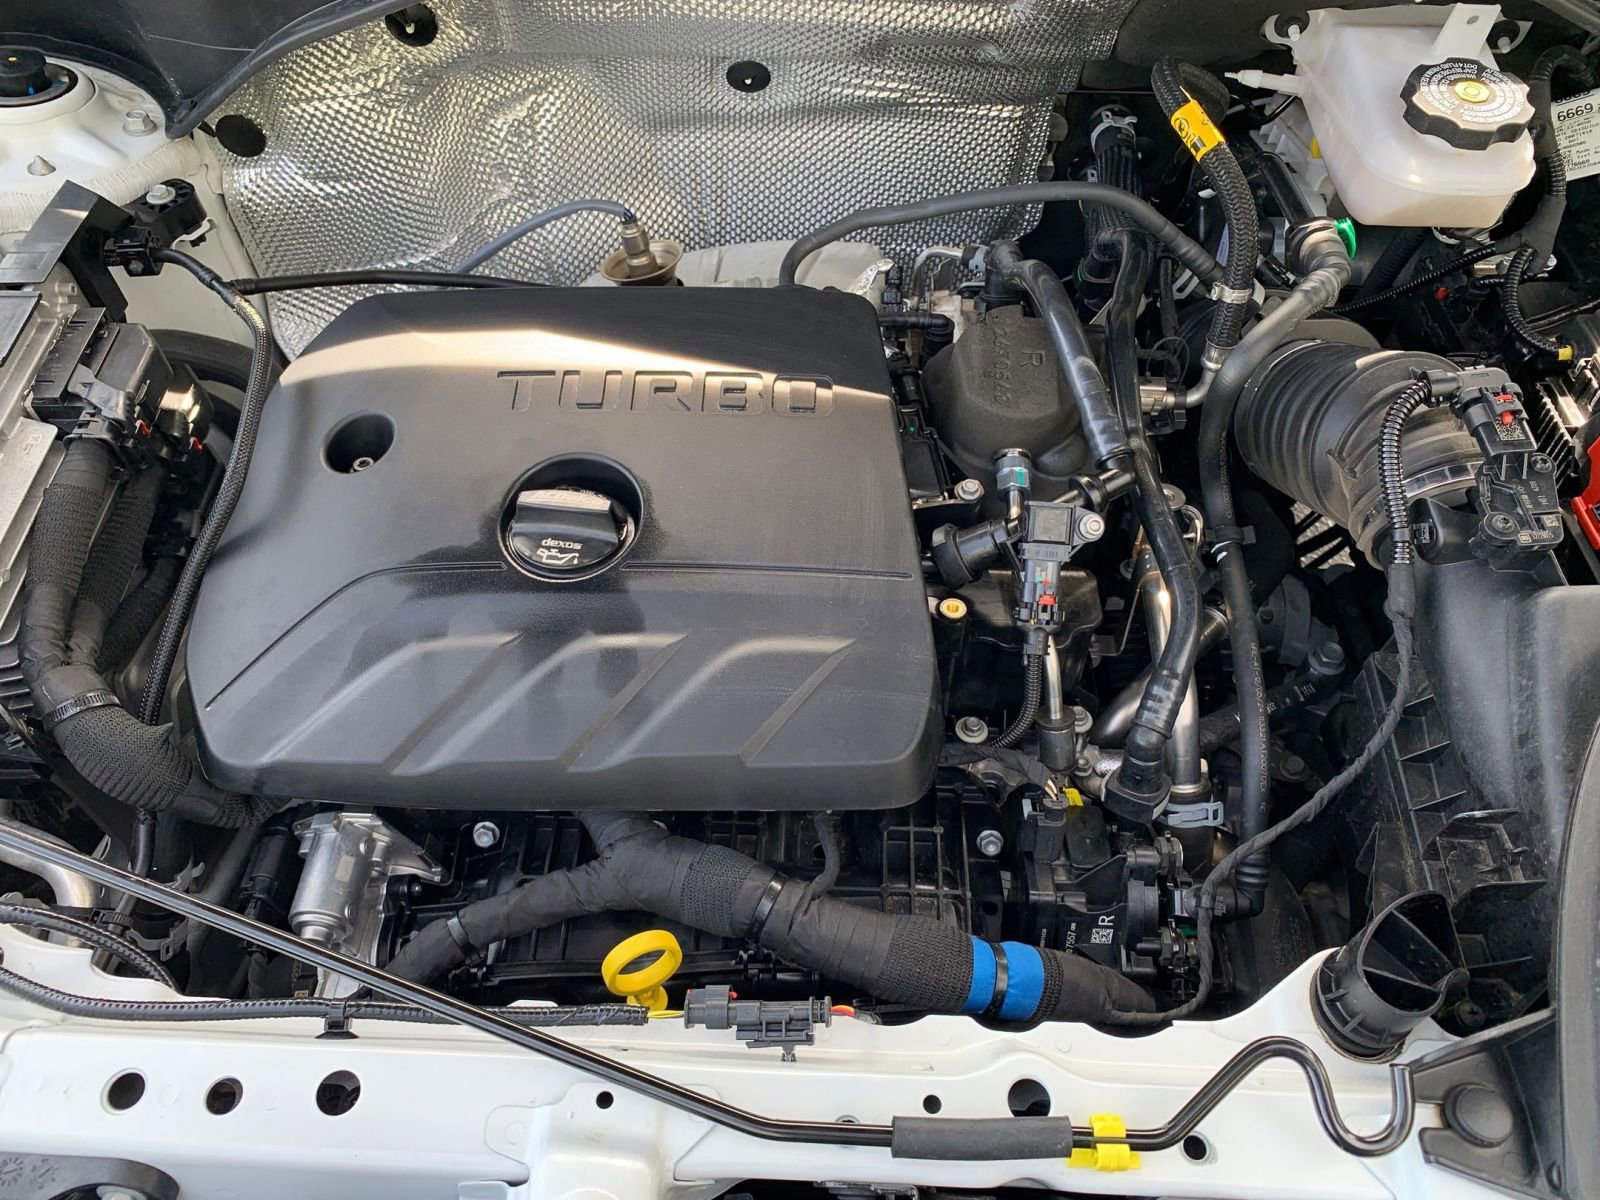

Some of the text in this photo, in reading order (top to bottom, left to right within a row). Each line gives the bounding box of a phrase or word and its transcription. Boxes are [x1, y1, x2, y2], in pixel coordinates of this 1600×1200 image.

[1557, 103, 1593, 122] 6669
[497, 369, 834, 417] TURBO
[541, 537, 584, 550] dexos
[1098, 915, 1115, 925] R
